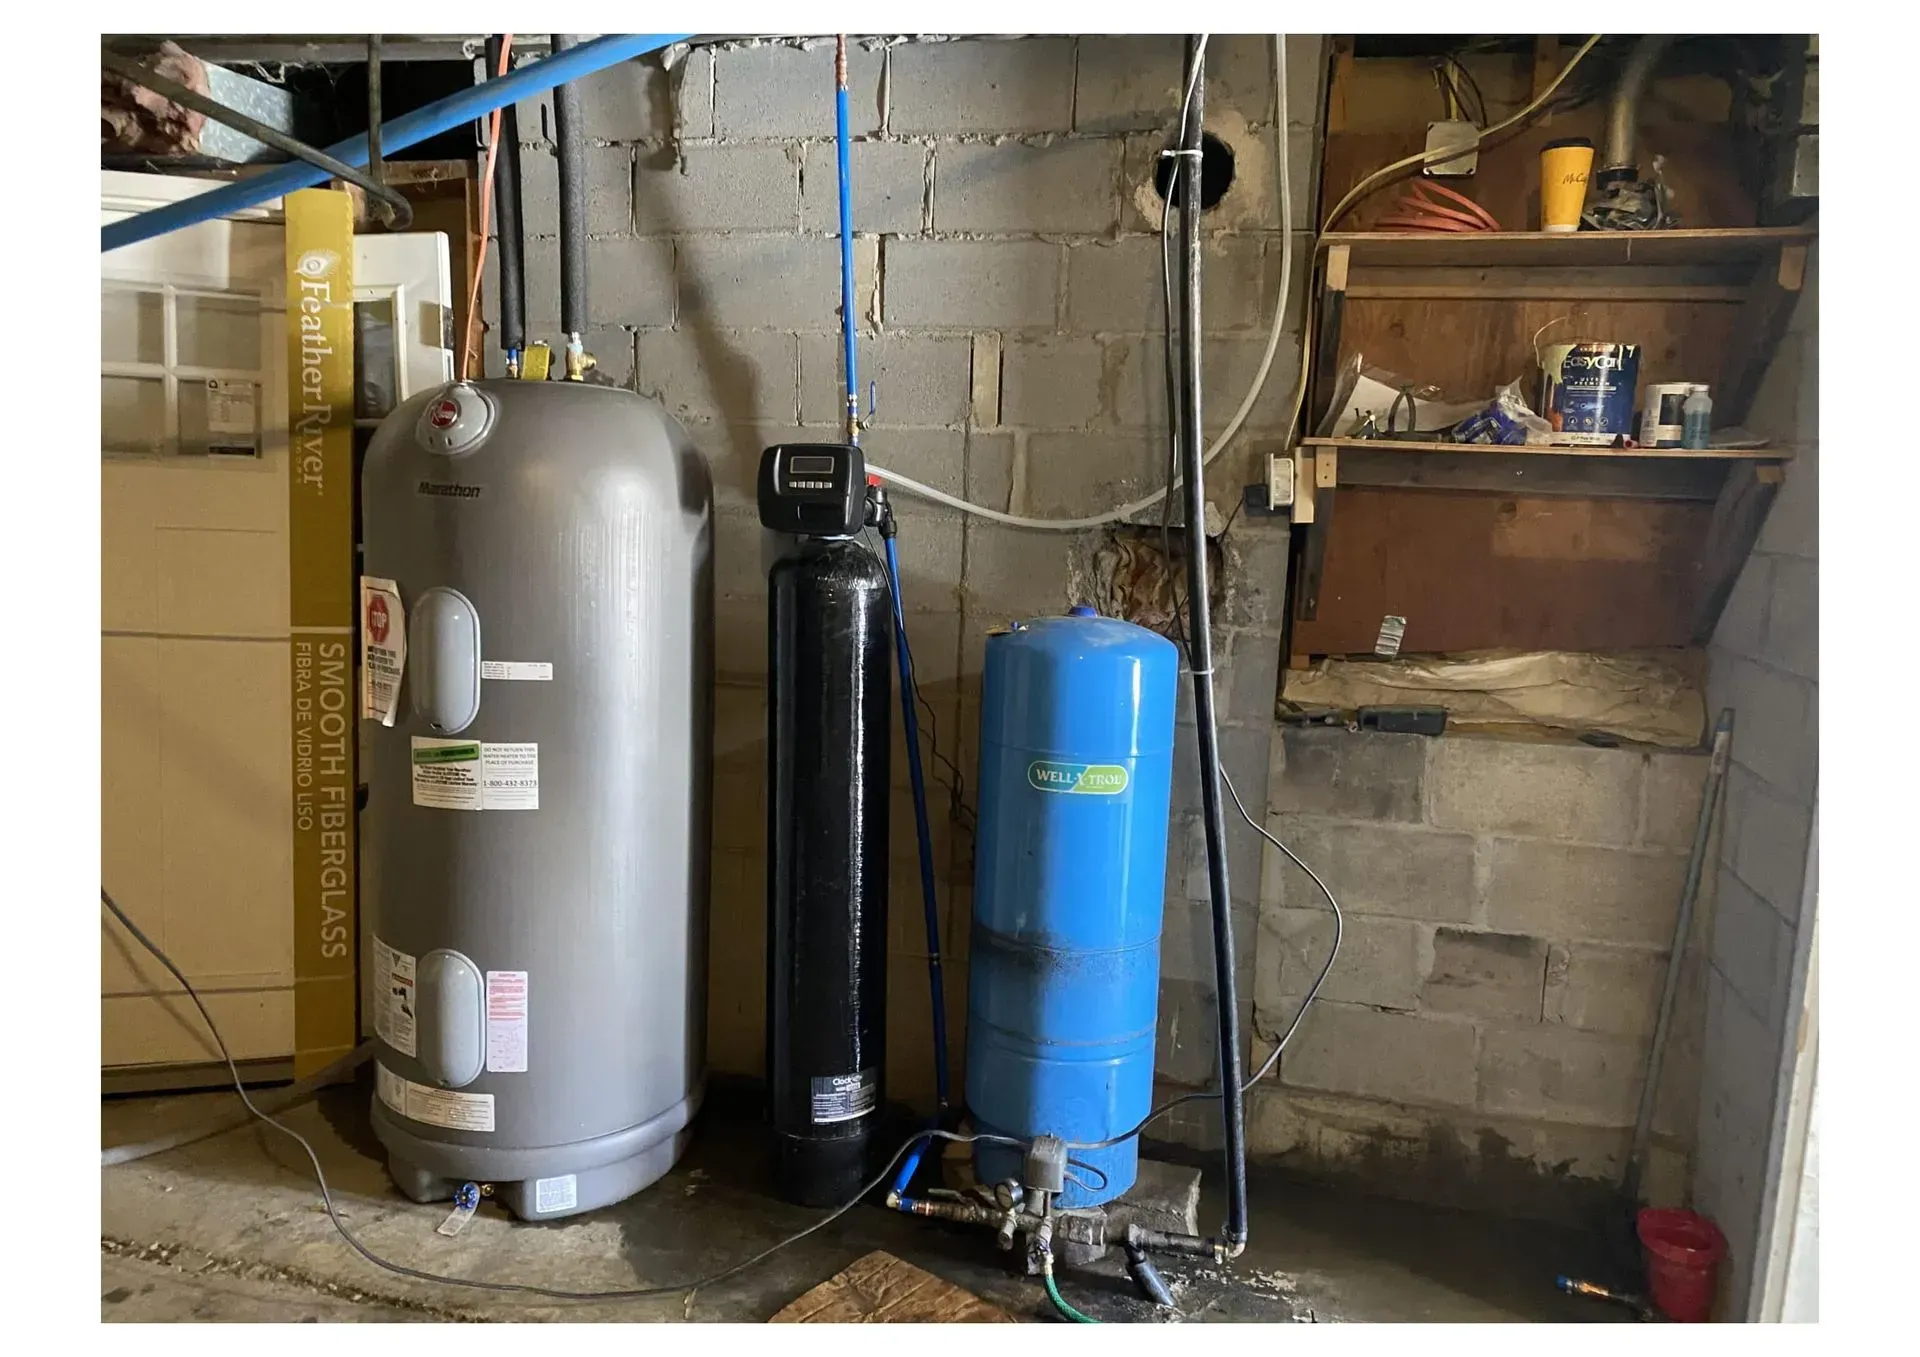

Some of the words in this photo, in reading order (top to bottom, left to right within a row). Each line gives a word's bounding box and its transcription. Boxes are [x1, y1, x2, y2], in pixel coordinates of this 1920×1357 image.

[418, 482, 481, 498] Marathon
[296, 642, 312, 692] FIBRA
[296, 698, 312, 722] DE
[319, 642, 346, 775] SMOOTH
[296, 727, 313, 788] VIDRIO
[297, 792, 313, 831] LISO
[320, 786, 347, 958] FIBERGLASS
